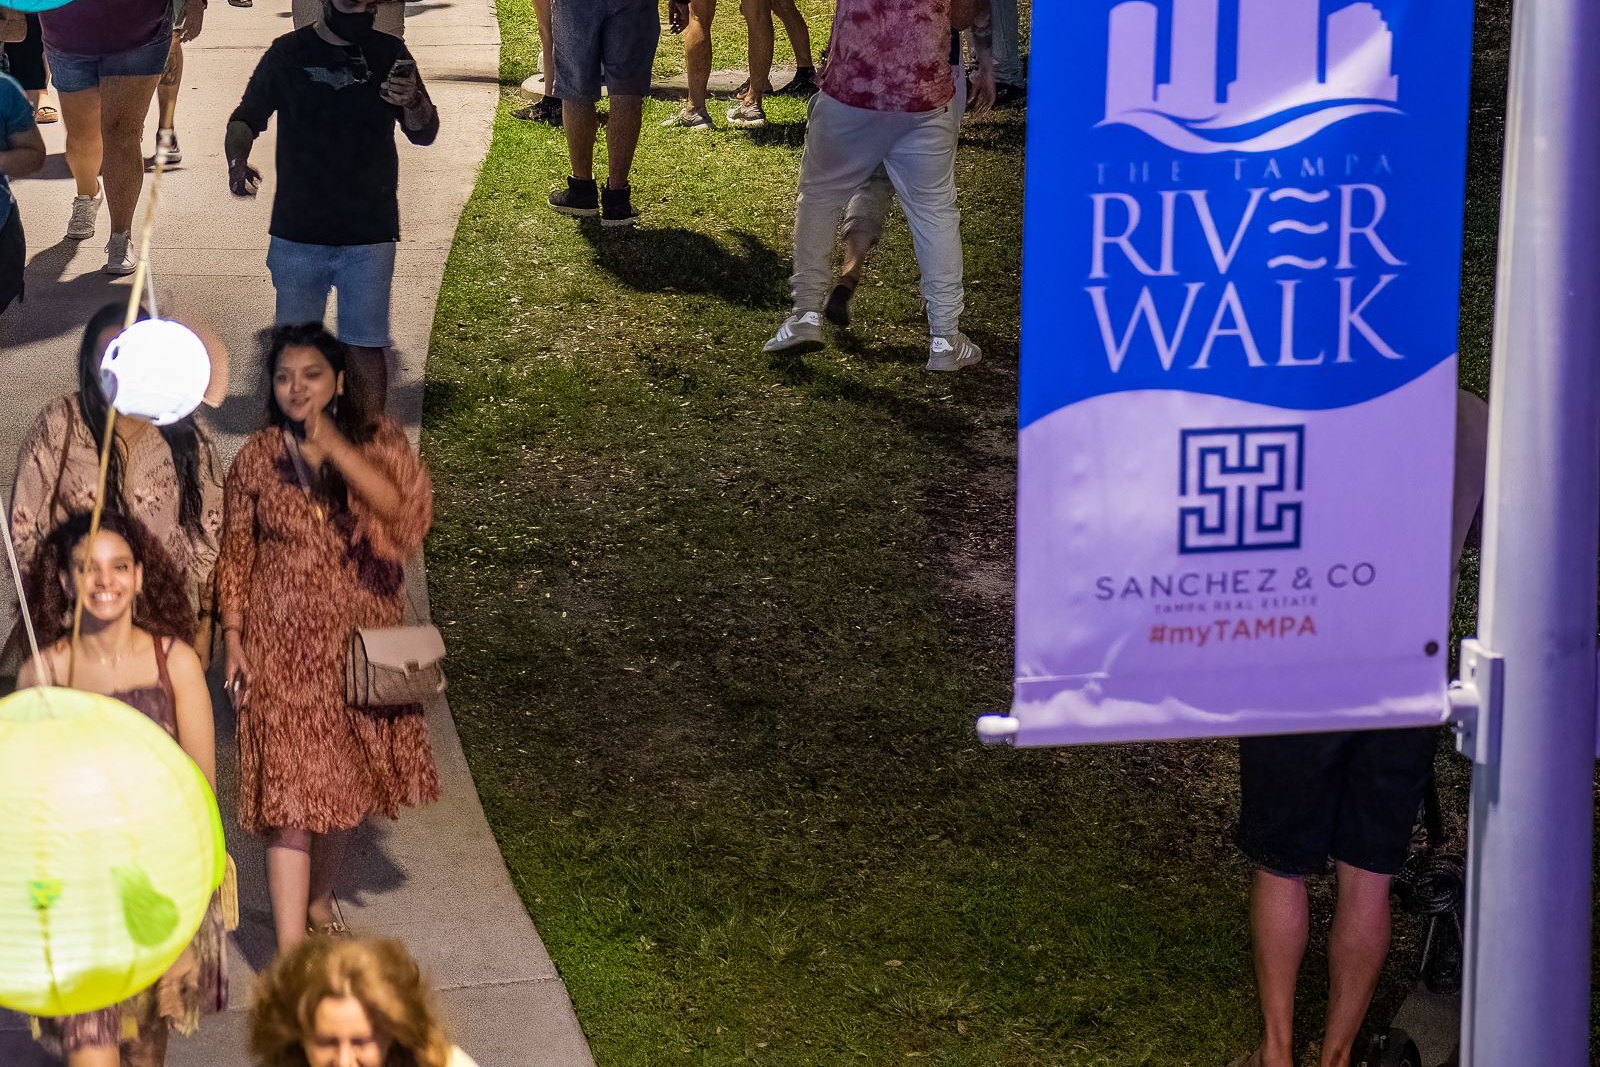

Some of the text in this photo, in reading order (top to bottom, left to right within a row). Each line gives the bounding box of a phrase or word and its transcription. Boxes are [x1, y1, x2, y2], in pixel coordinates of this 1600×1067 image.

[1094, 154, 1392, 184] THE TAMPA
[1088, 183, 1407, 279] RIVER
[1084, 274, 1405, 374] WALK
[1095, 562, 1377, 601] SANCHEZ & CO
[1155, 596, 1318, 614] TAMPA REAL ESTATE
[1149, 615, 1318, 647] #myTAMPA
